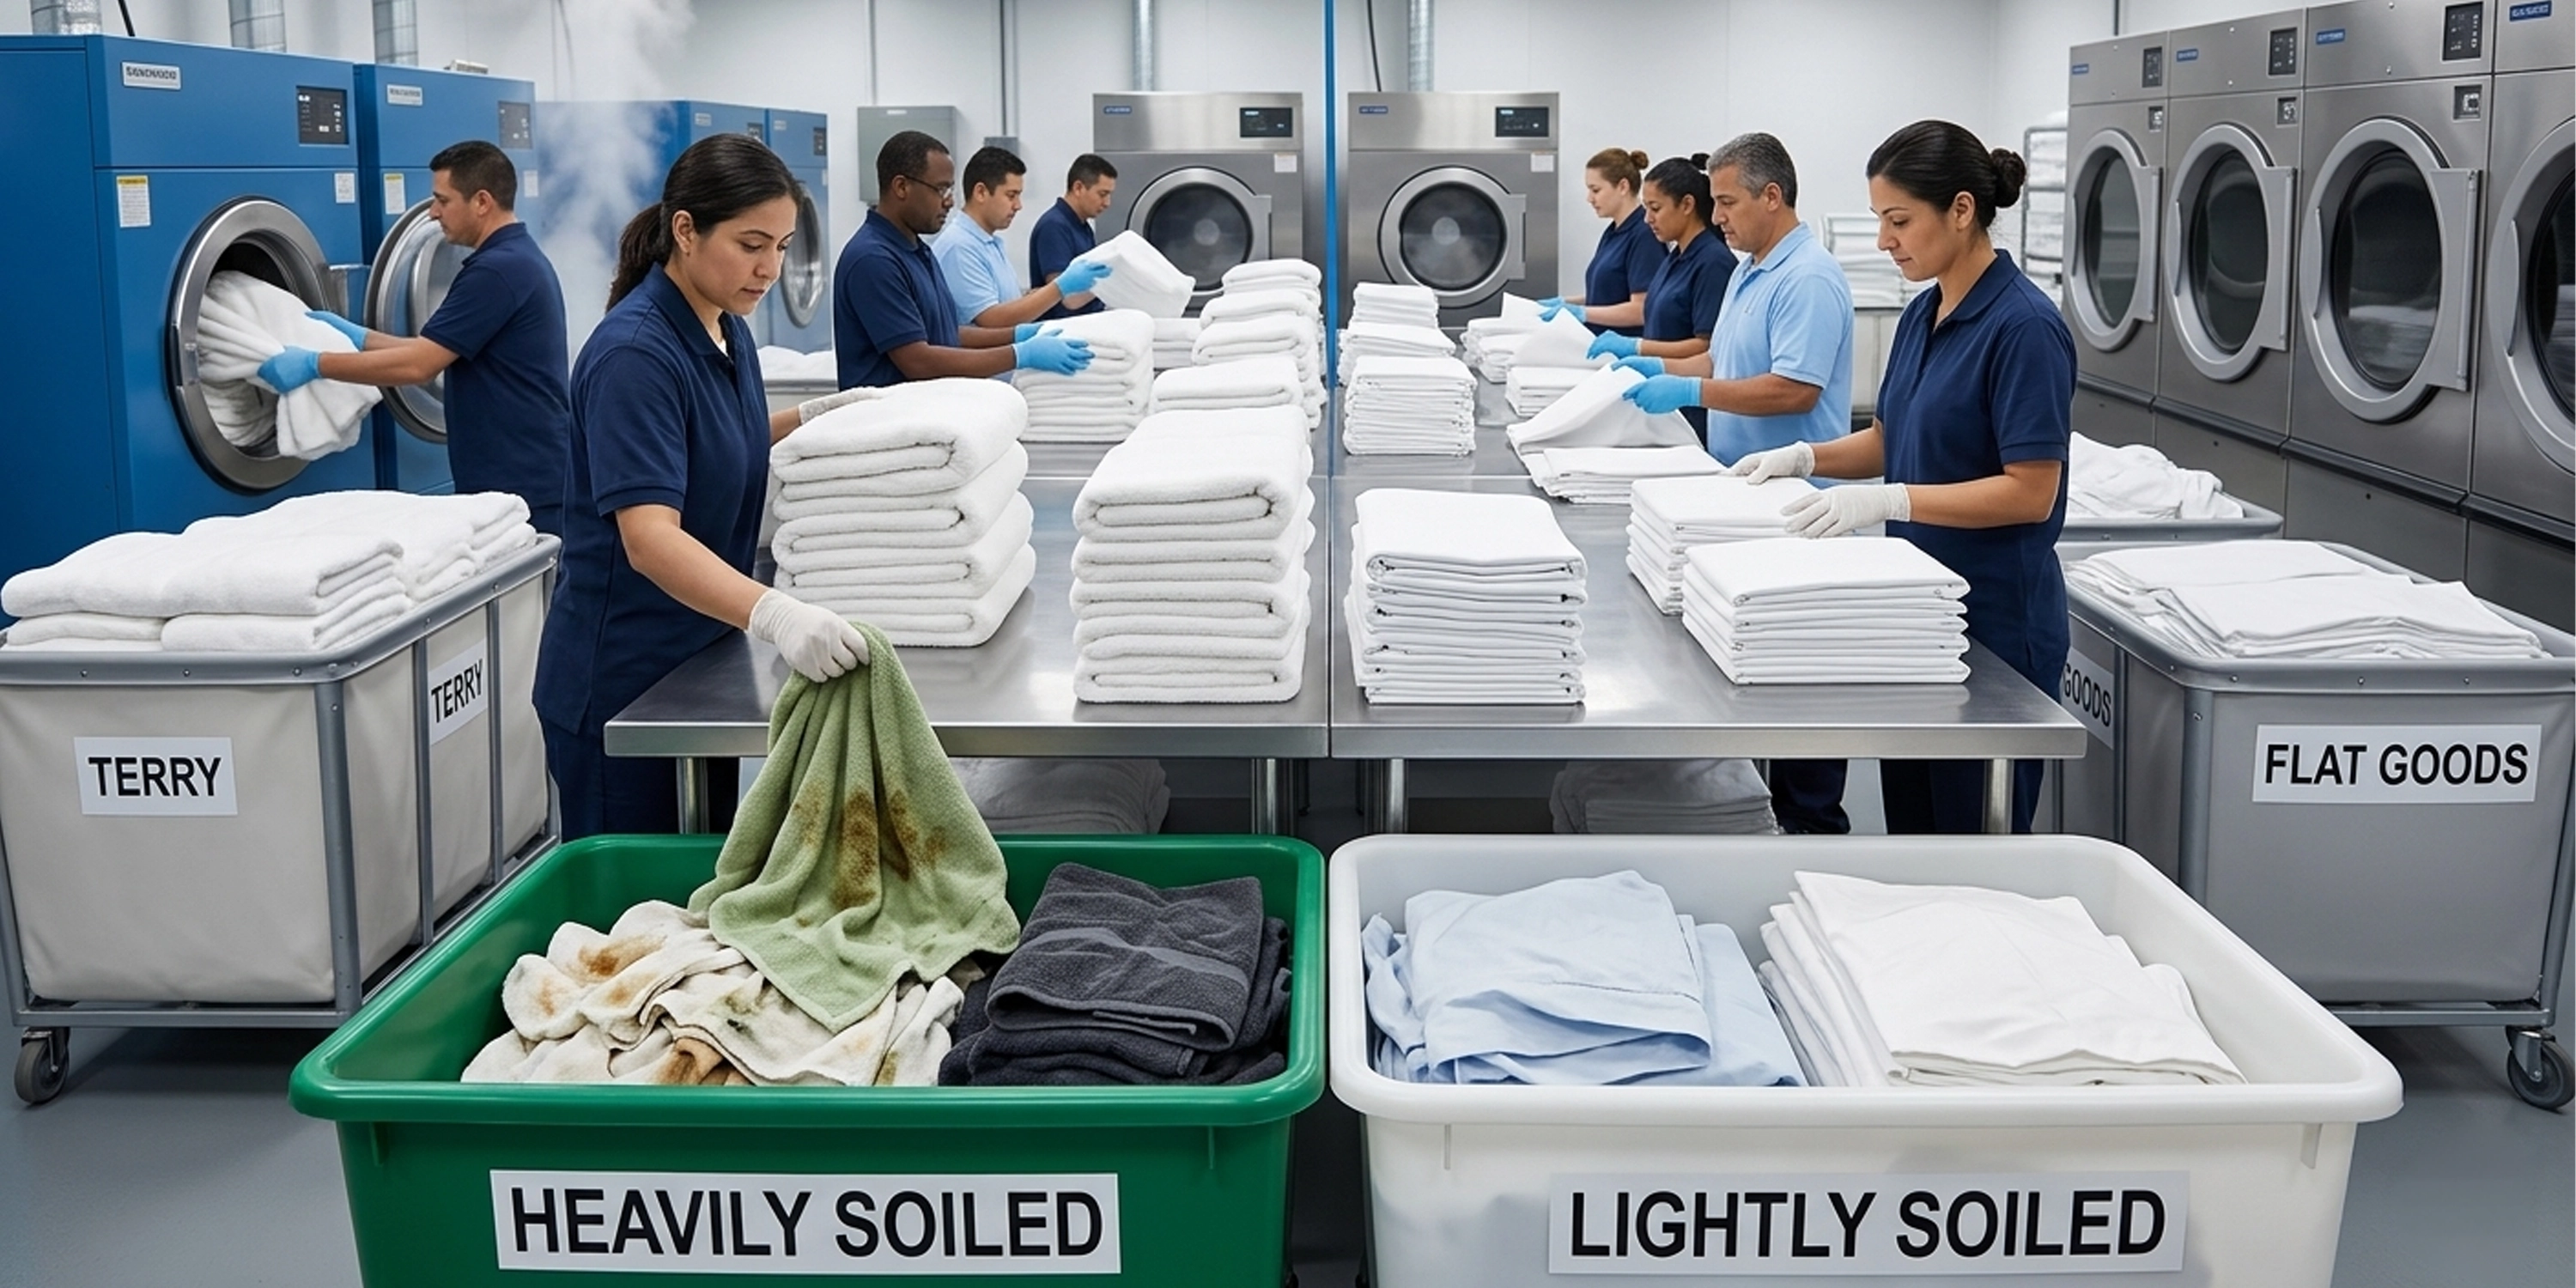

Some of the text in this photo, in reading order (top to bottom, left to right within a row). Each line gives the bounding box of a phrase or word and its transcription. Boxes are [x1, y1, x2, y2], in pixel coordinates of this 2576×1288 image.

[430, 659, 483, 723] TERRY
[2063, 662, 2111, 728] GOODS
[88, 756, 222, 797] TERRY
[2265, 744, 2528, 786] FLAT GOODS
[511, 1187, 1103, 1258] HEAVILY SOILED
[1571, 1189, 2166, 1258] LIGHTLY SOILED
